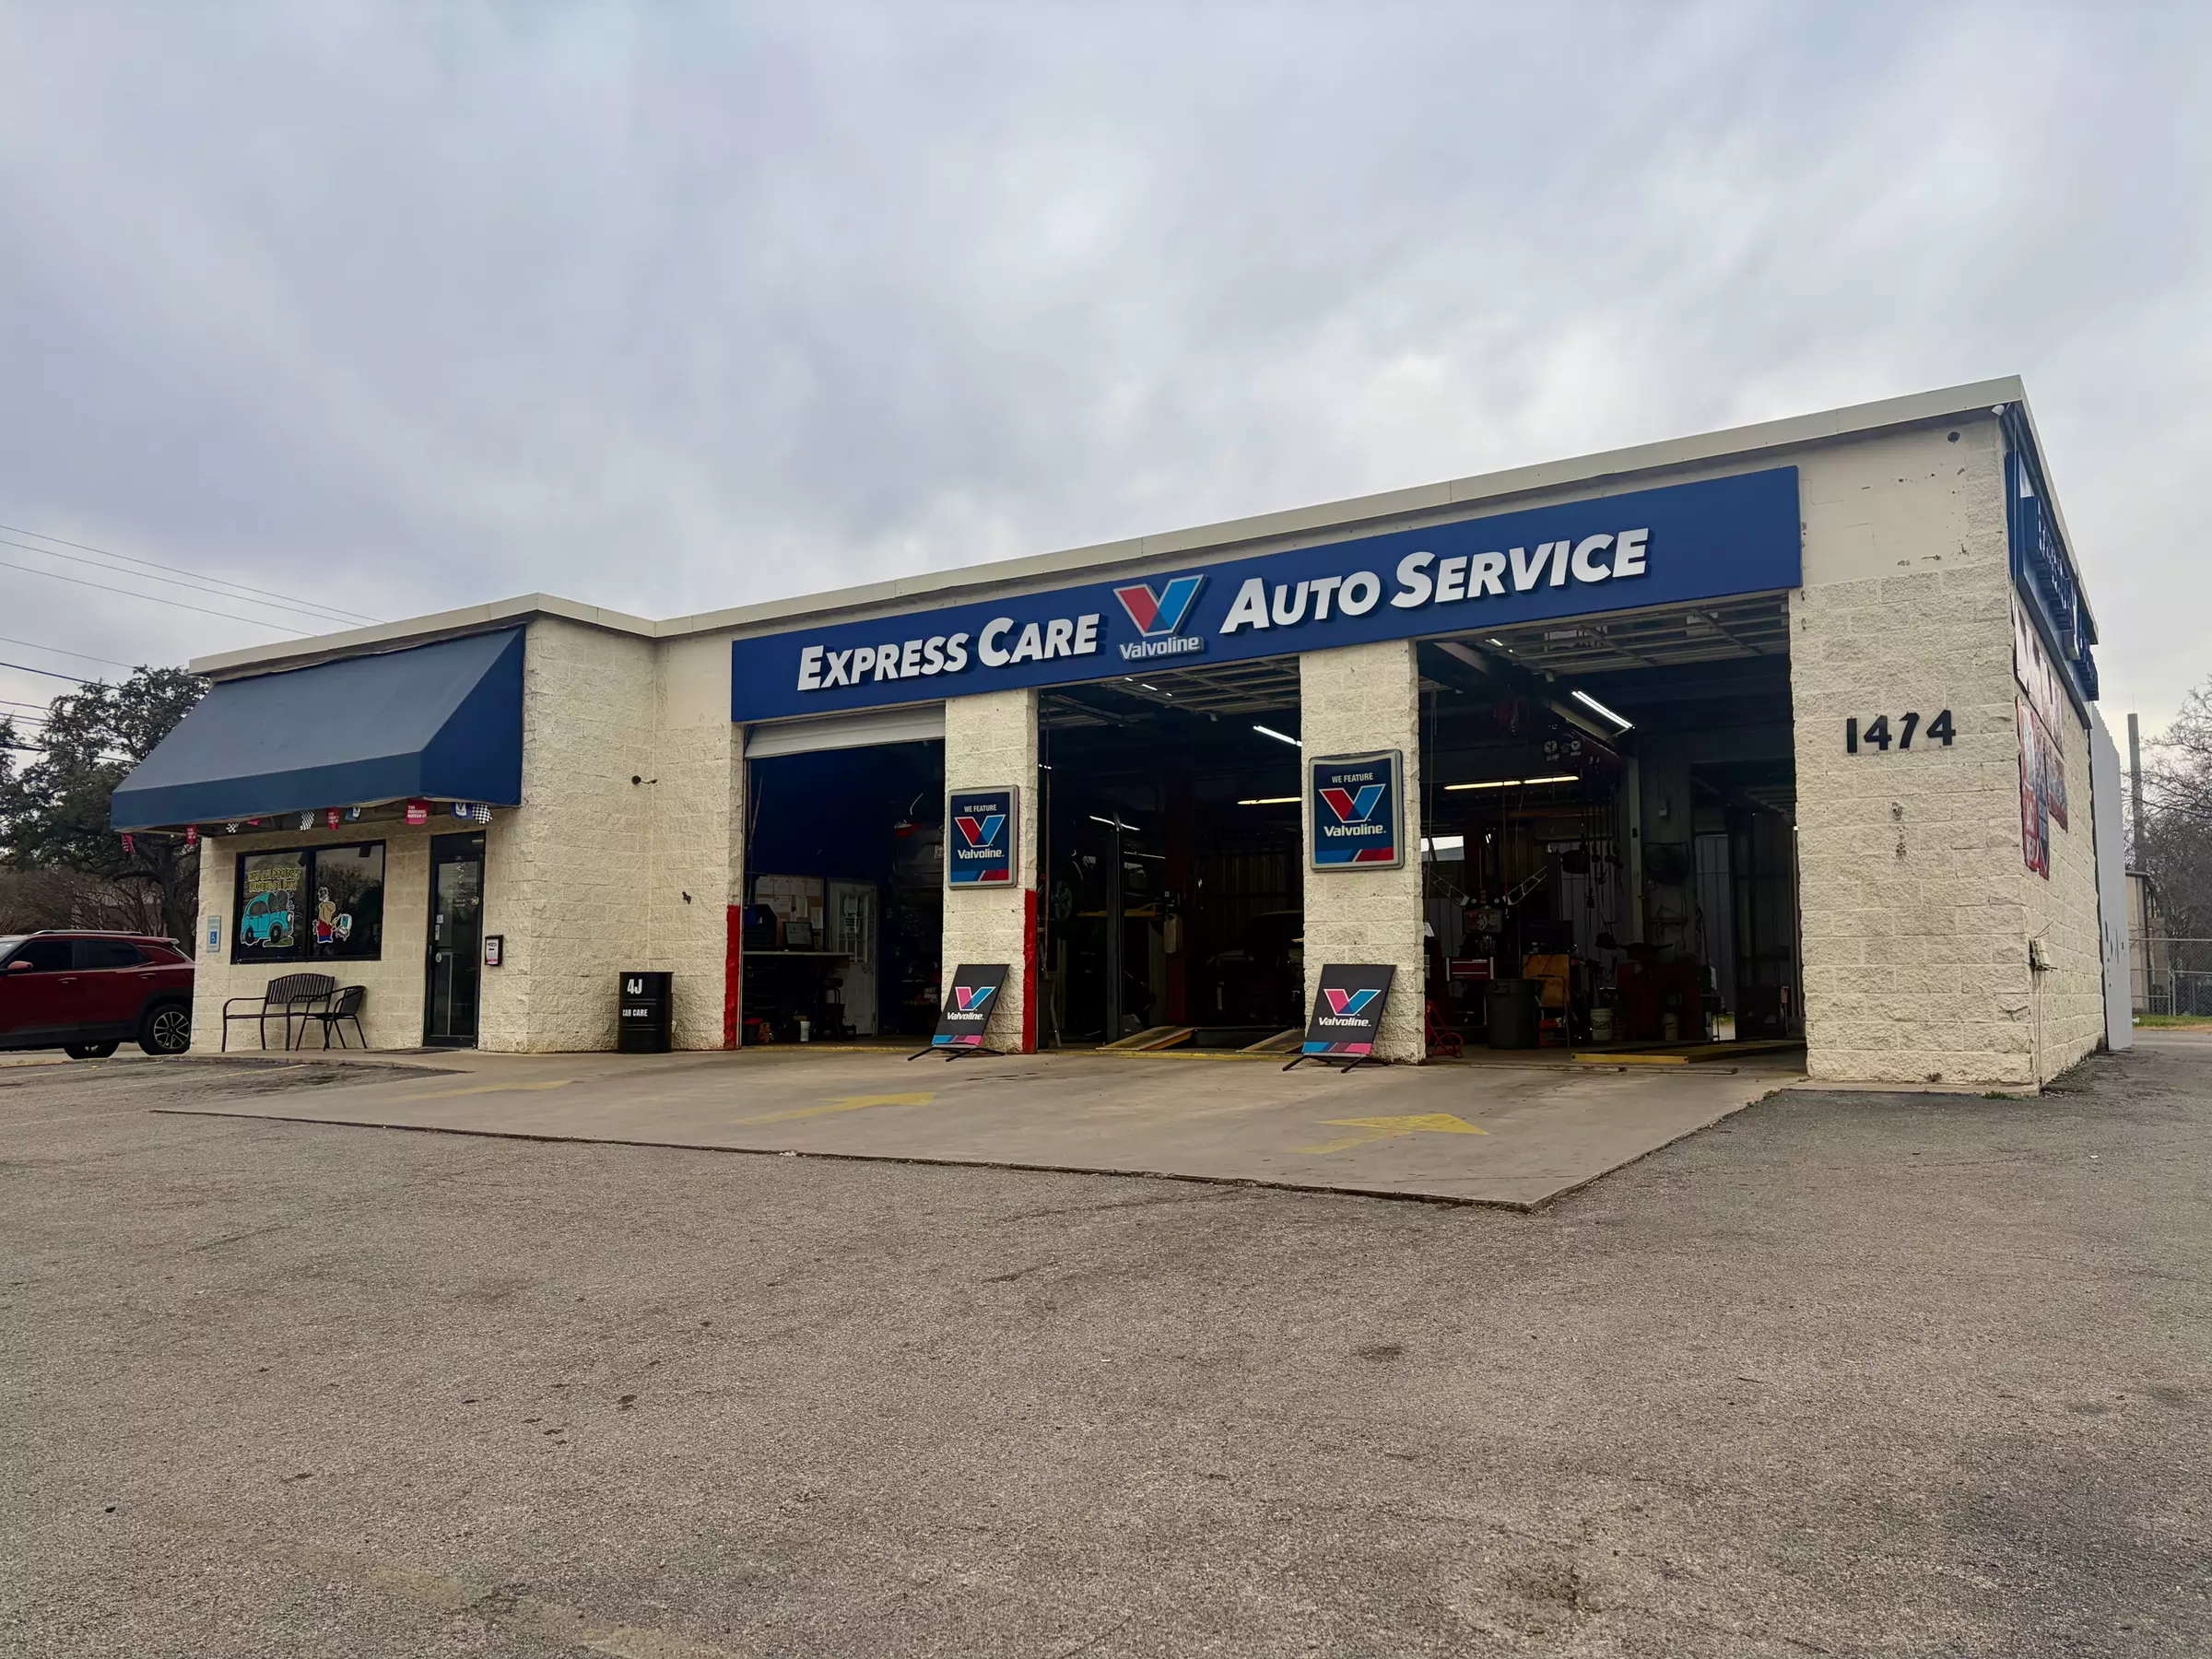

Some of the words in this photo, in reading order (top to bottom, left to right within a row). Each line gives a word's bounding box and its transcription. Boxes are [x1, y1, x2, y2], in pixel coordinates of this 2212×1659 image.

[1219, 571, 1381, 634] AUTO
[1390, 528, 1650, 608] SERVICE
[797, 633, 970, 690] EXPRESS
[978, 613, 1100, 666] CARE
[1120, 636, 1200, 660] Valvoline
[1846, 709, 1956, 753] 1474
[1332, 775, 1342, 783] WE
[1344, 772, 1373, 782] FEATURE
[973, 804, 996, 812] FEATURE
[1324, 823, 1384, 837] Valvoline
[958, 848, 1004, 859] Valvoline
[627, 979, 642, 994] 4J
[632, 1008, 648, 1017] CARE
[947, 1012, 983, 1020] Valvoline
[1318, 1017, 1370, 1027] Valvoline
